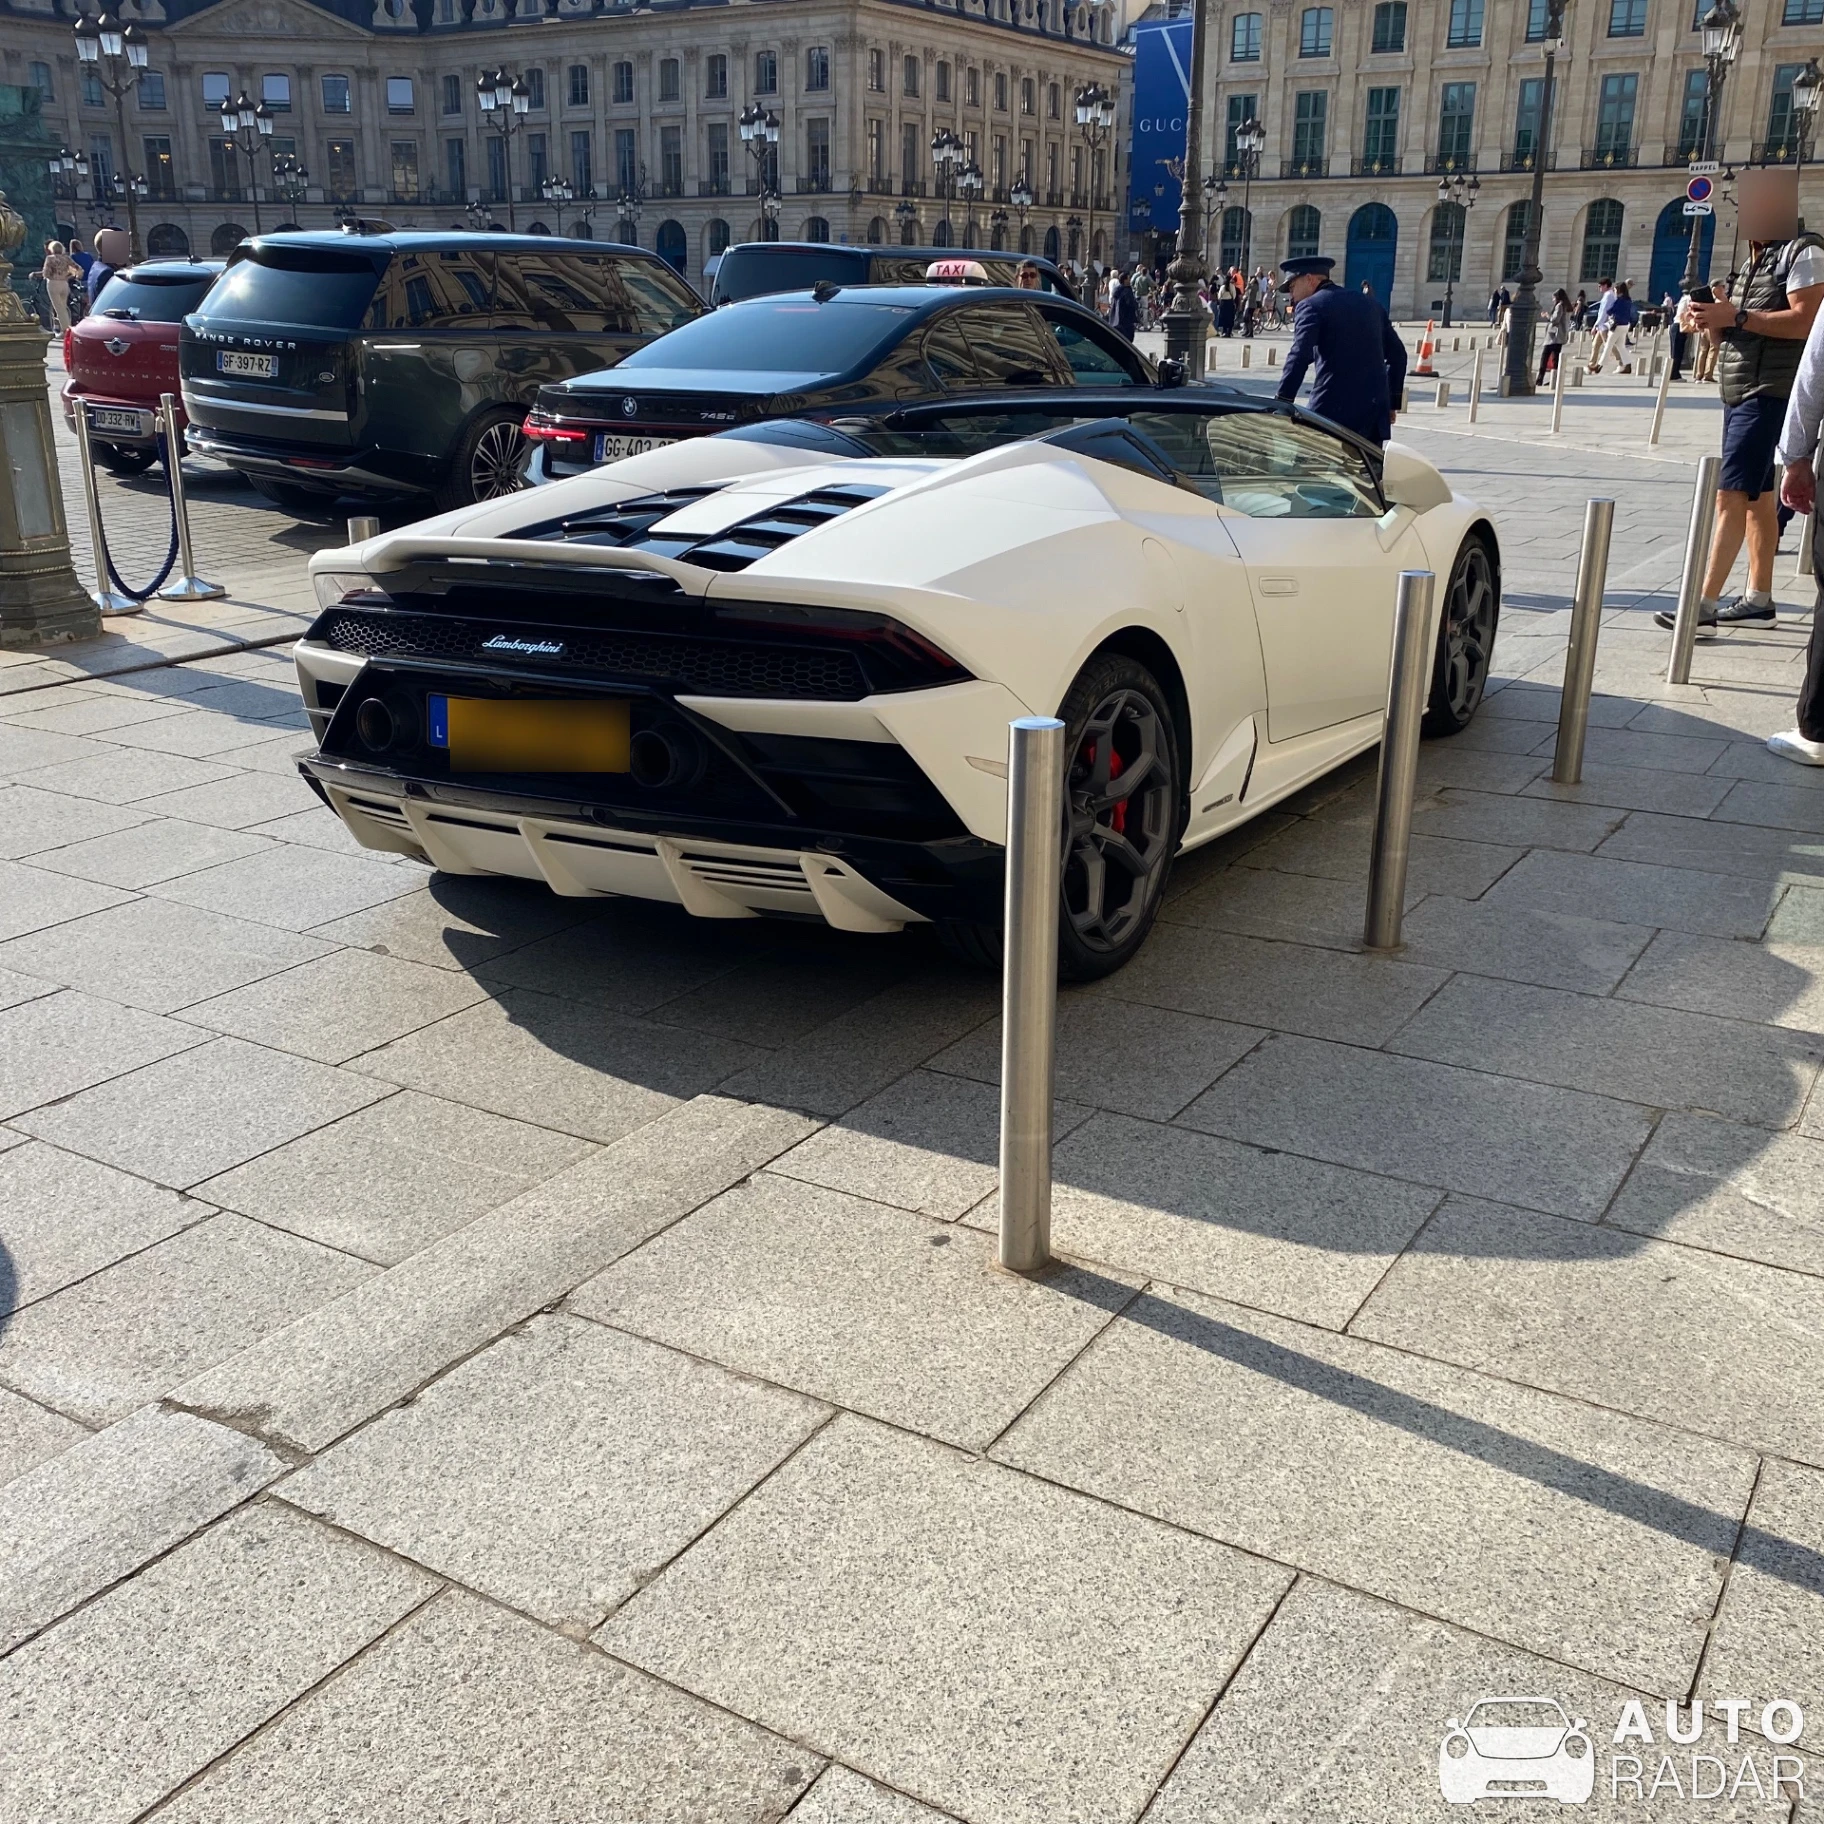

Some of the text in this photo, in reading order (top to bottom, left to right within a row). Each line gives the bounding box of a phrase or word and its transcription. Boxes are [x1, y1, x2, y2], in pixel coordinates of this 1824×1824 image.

[1139, 117, 1183, 133] GUC
[935, 264, 966, 276] TAXI
[195, 331, 297, 350] RANGE ROVER
[223, 354, 272, 373] GF-397-RZ
[78, 367, 175, 381] COUNTRYMAN
[481, 634, 564, 655] Lamborghini
[436, 725, 443, 739] L
